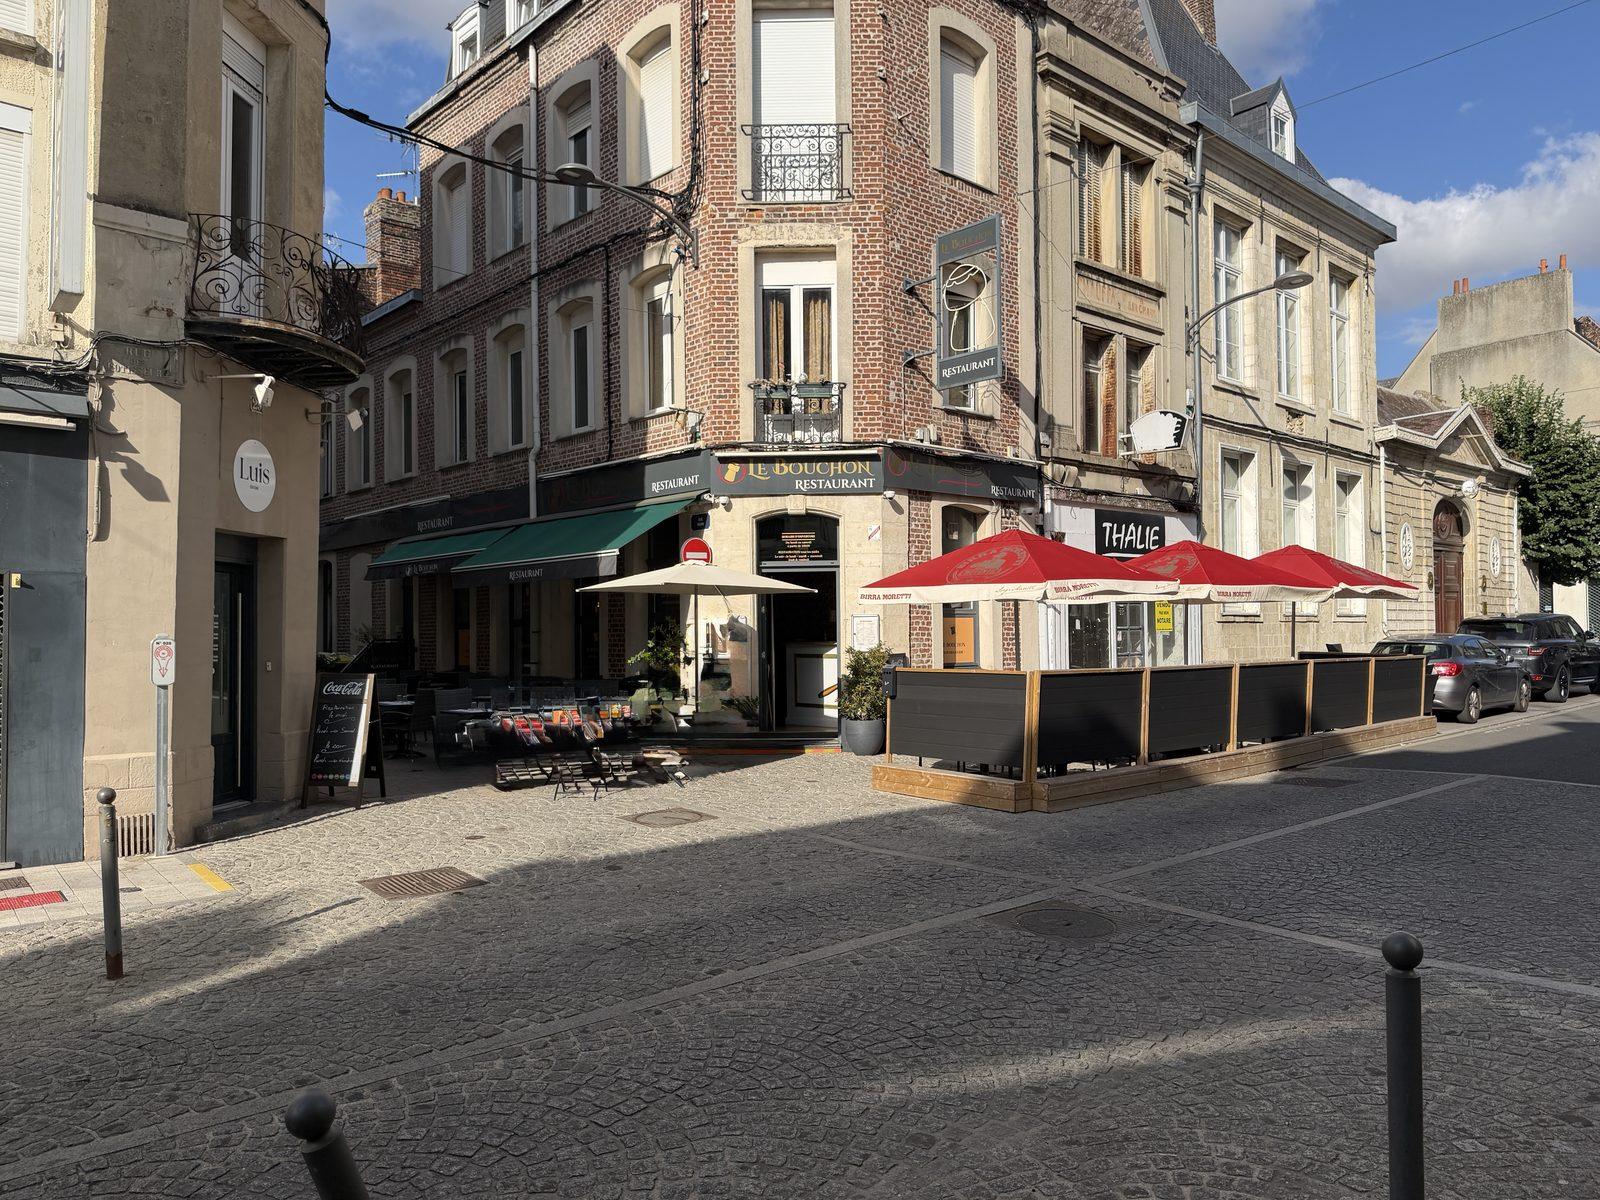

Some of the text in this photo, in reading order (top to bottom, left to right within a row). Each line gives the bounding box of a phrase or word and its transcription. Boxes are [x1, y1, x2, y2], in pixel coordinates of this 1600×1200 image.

[942, 357, 996, 378] RESTAURANT
[240, 457, 270, 485] Luis
[749, 458, 874, 480] LE BOUCHON
[652, 475, 700, 493] RESTAURANT
[795, 478, 876, 491] RESTAURANT
[991, 485, 1036, 499] RESTAURANT
[417, 516, 456, 533] RESTAURANT
[1102, 522, 1160, 550] THALIE
[509, 568, 543, 581] RESTAURANT
[1072, 582, 1099, 591] MORETTI
[323, 681, 365, 697] Coca-Cola
